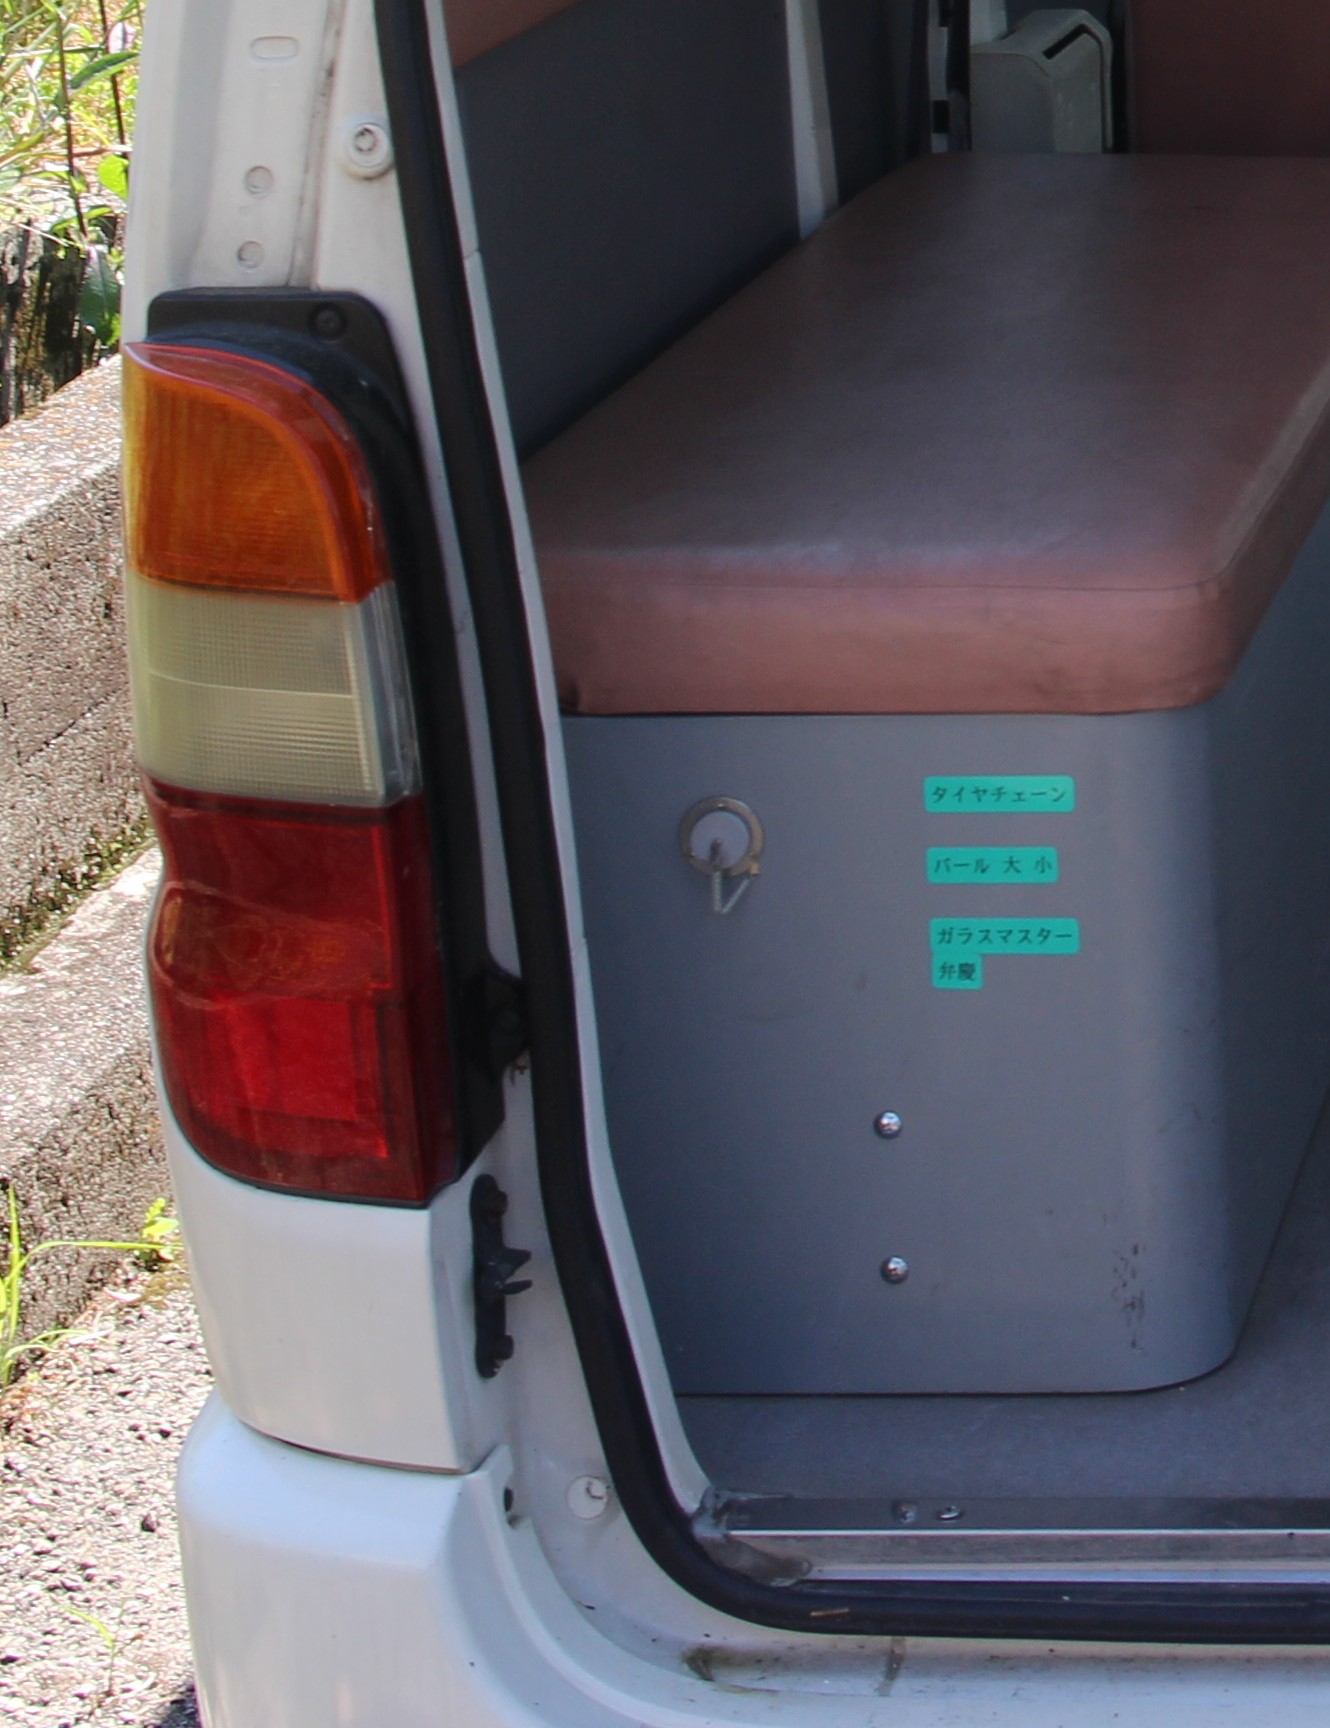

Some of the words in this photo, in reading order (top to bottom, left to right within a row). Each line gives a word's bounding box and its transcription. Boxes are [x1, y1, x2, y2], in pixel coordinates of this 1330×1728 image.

[932, 787, 1066, 803] タイヤチェーン
[934, 857, 990, 874] バール
[1004, 856, 1021, 874] 大
[1035, 856, 1053, 874] 小
[937, 927, 1073, 945] ガラスマスター
[938, 962, 977, 981] 弁慶
